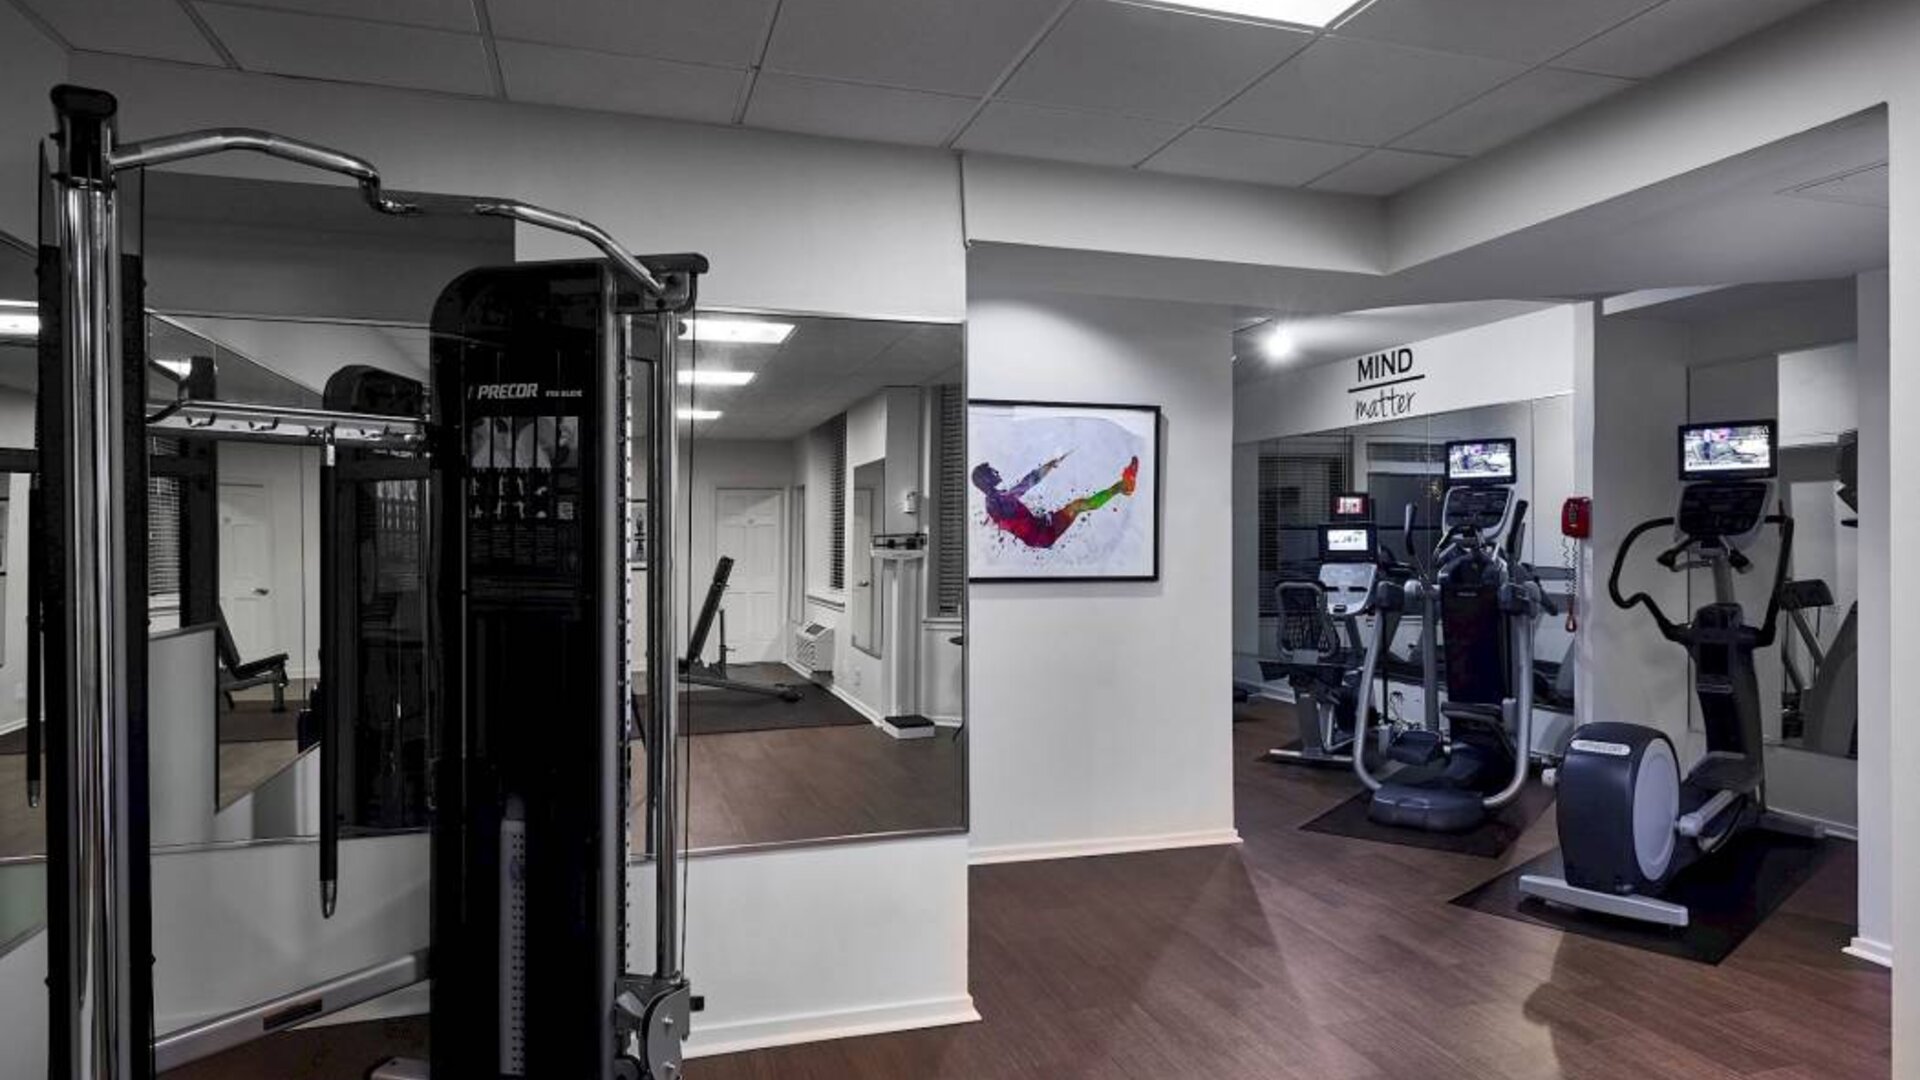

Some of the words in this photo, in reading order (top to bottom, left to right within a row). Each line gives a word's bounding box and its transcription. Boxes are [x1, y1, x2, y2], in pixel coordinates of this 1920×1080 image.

[1358, 348, 1413, 382] MIND
[478, 383, 538, 399] PRECOR
[1356, 387, 1416, 420] matter
